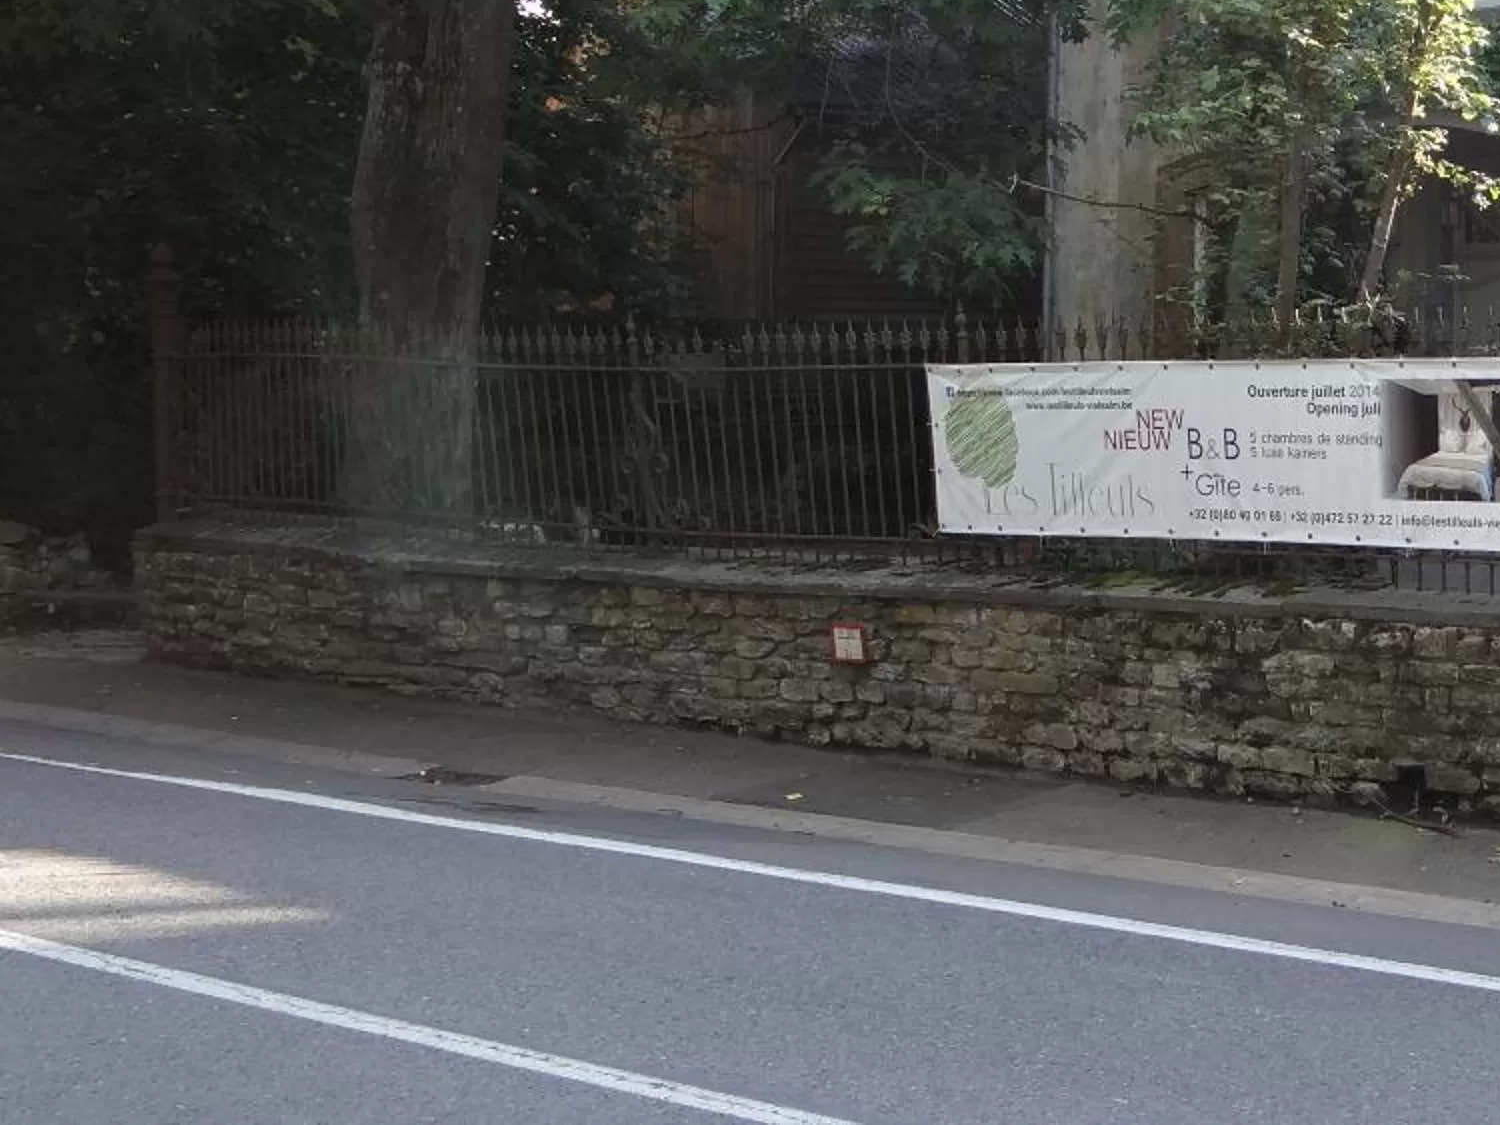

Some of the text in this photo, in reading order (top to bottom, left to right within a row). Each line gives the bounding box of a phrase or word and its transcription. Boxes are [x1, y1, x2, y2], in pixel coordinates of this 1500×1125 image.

[1247, 385, 1309, 399] Ouverture
[1311, 385, 1346, 401] juillet
[1306, 401, 1381, 418] Opening juli
[1136, 408, 1185, 431] NEW
[1104, 429, 1172, 451] NIEUW
[1260, 431, 1313, 446] chambres
[1316, 432, 1331, 446] de
[1335, 433, 1383, 449] standing
[1252, 481, 1275, 495] 4-6
[1188, 508, 1207, 521] +32
[1379, 513, 1393, 526] 22
